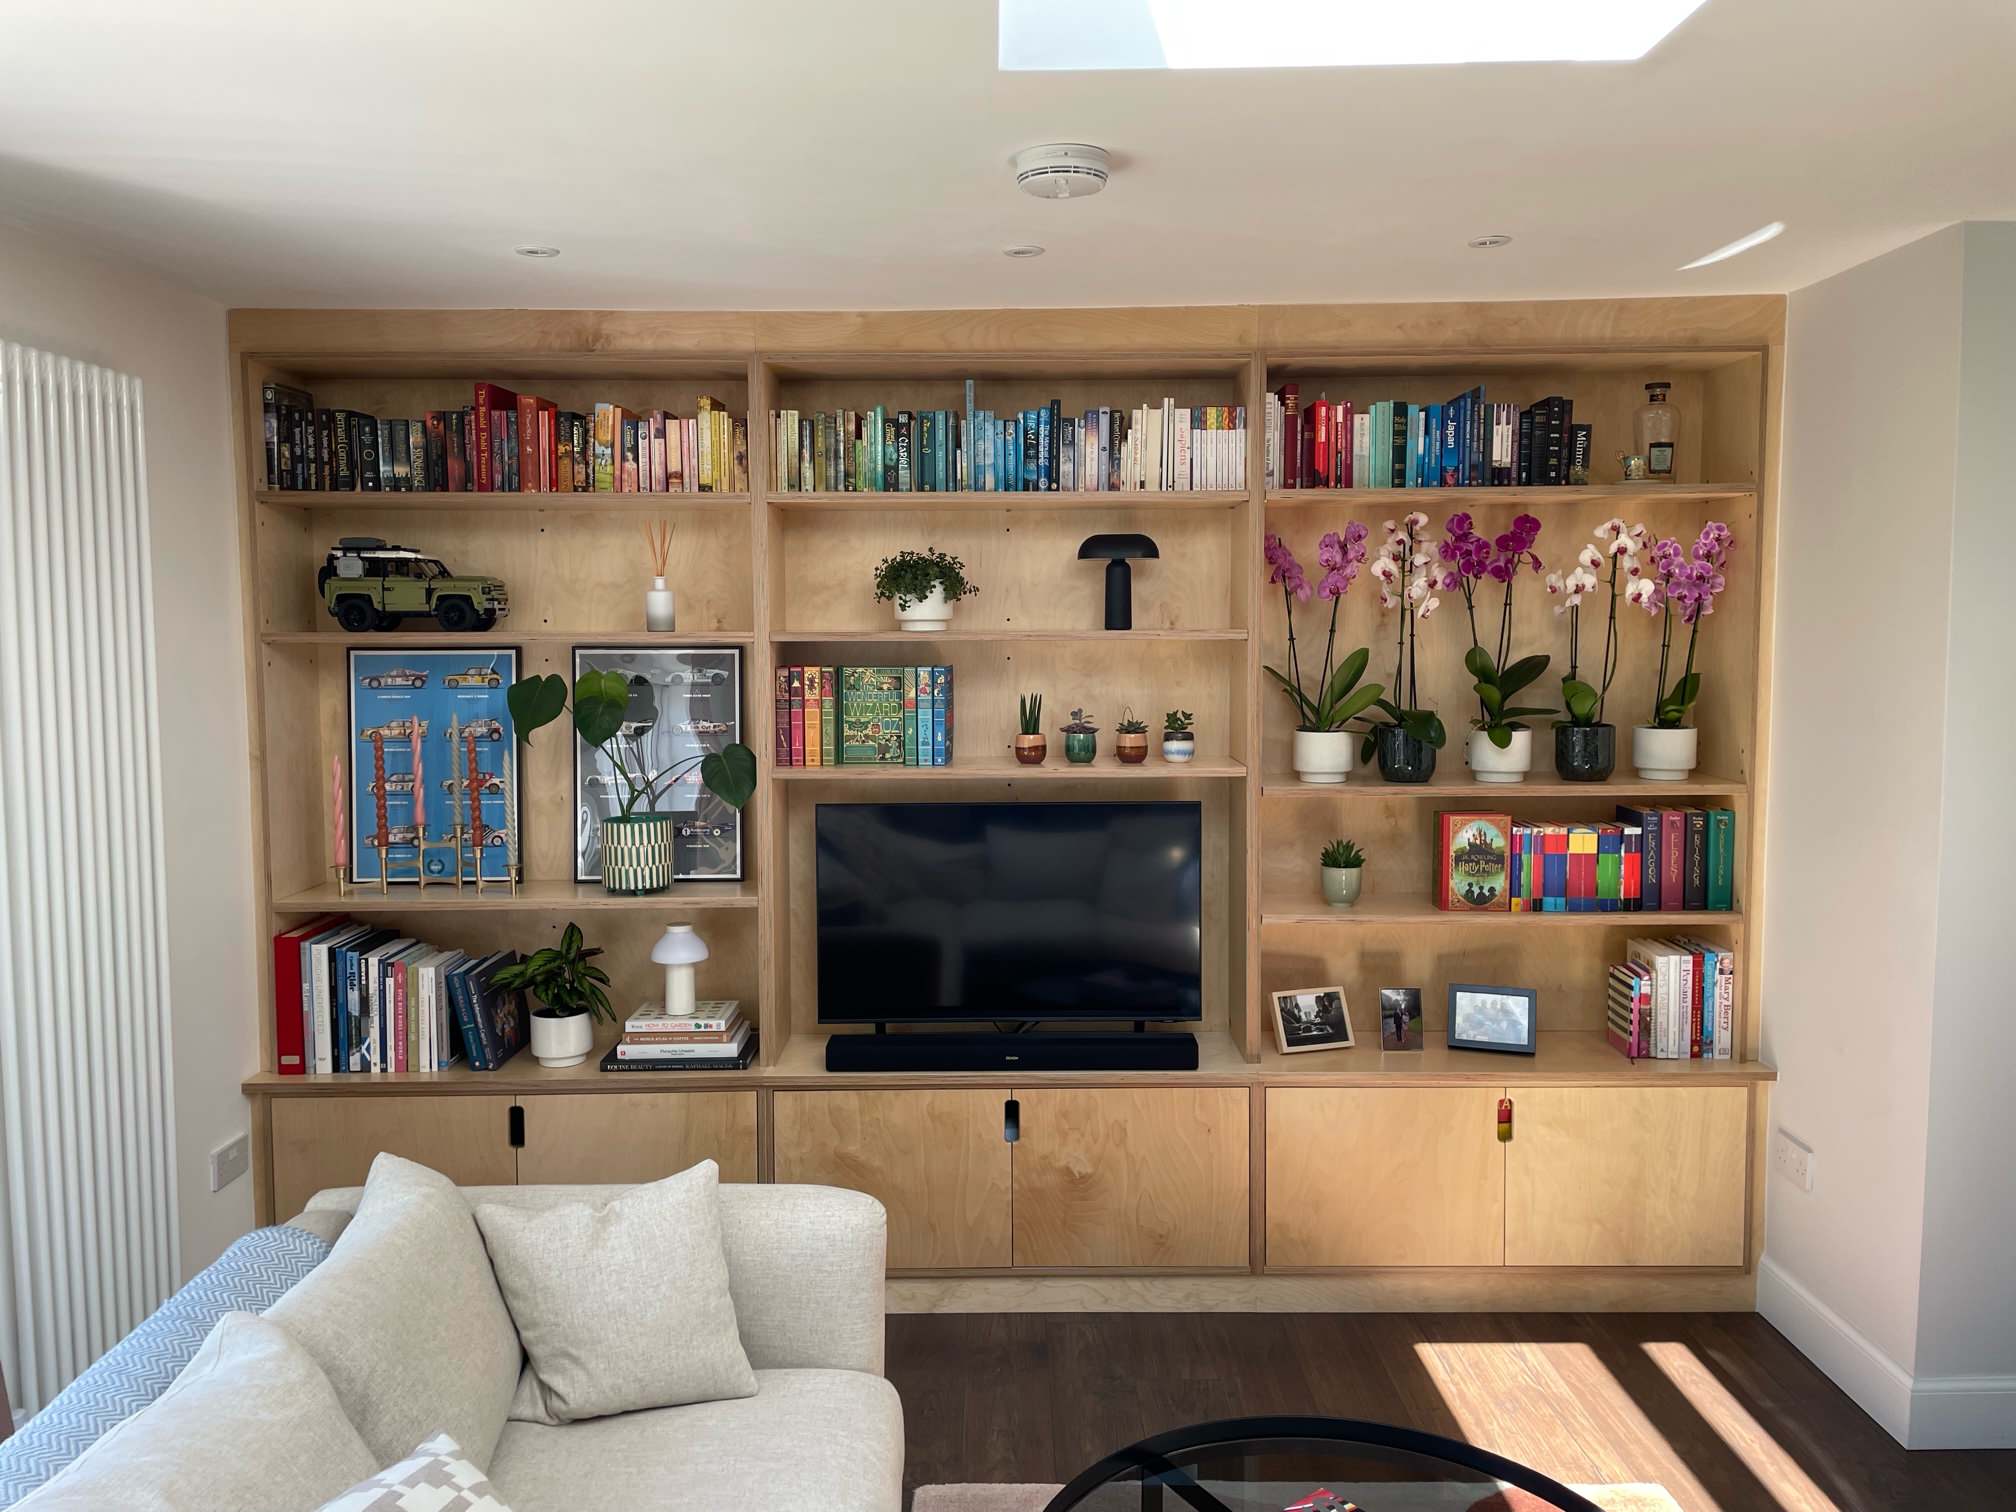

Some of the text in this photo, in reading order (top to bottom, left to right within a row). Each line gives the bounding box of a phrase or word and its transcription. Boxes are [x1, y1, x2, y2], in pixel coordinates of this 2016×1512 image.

[336, 412, 350, 476] Bernard Cornwell
[1445, 420, 1457, 448] Japan
[1575, 431, 1587, 471] Munros
[414, 448, 424, 487] STONEHENGE
[480, 452, 488, 484] Treasury
[847, 691, 900, 701] WONDERFUL
[848, 703, 899, 716] WIZARD
[882, 718, 899, 733] OZ
[1458, 860, 1503, 873] Harry Potter
[1647, 833, 1656, 884] ERAGON
[347, 971, 356, 992] Ride
[1682, 969, 1691, 1004] Persiana
[1722, 976, 1731, 1032] Mary Berry
